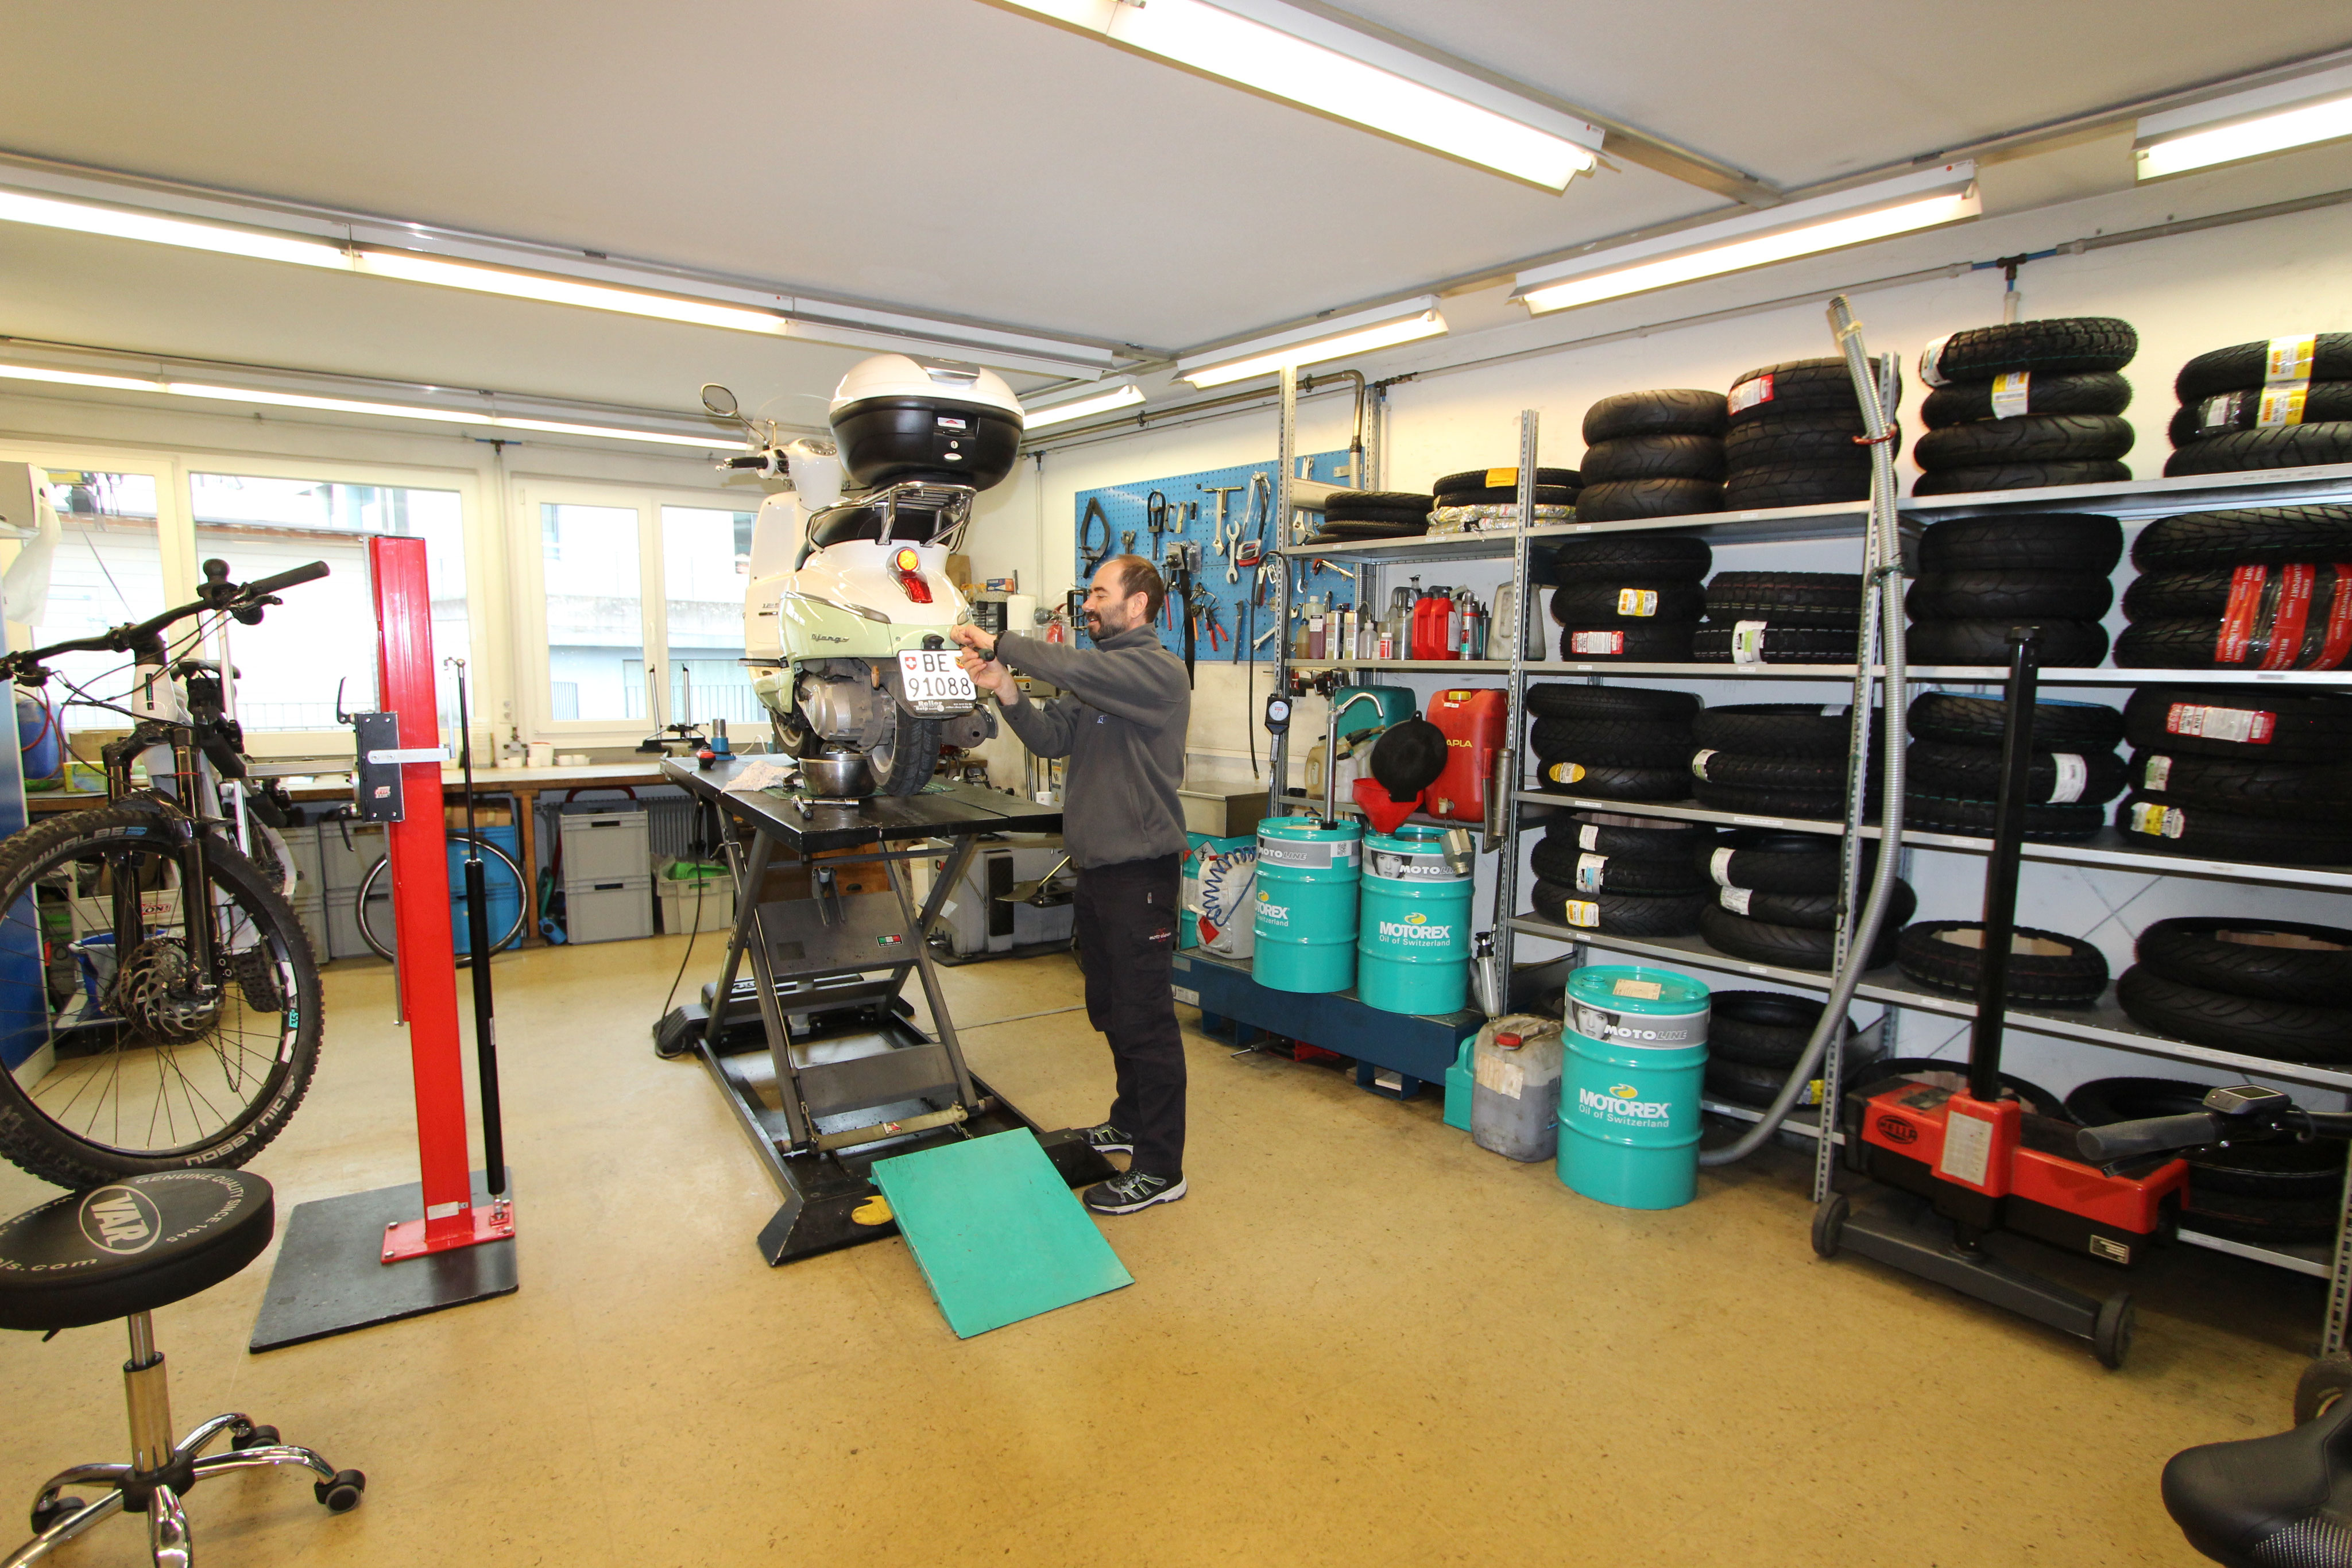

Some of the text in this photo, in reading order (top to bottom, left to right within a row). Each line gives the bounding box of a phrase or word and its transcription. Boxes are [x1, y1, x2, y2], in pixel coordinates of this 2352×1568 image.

[922, 653, 950, 672] BE
[908, 677, 971, 698] 91088
[1399, 865, 1456, 876] MOTOLI
[1255, 899, 1289, 920] OTOREX
[1379, 921, 1450, 939] MOTOREX
[1379, 934, 1389, 942] Oil
[1403, 939, 1450, 947] Switzerland
[1580, 1087, 1669, 1119] MOTOREX
[1579, 1104, 1670, 1128] Oil of Switzerland
[136, 1174, 244, 1242] GENUINE QUALITY SINCE 1945
[91, 1191, 150, 1248] VAR
